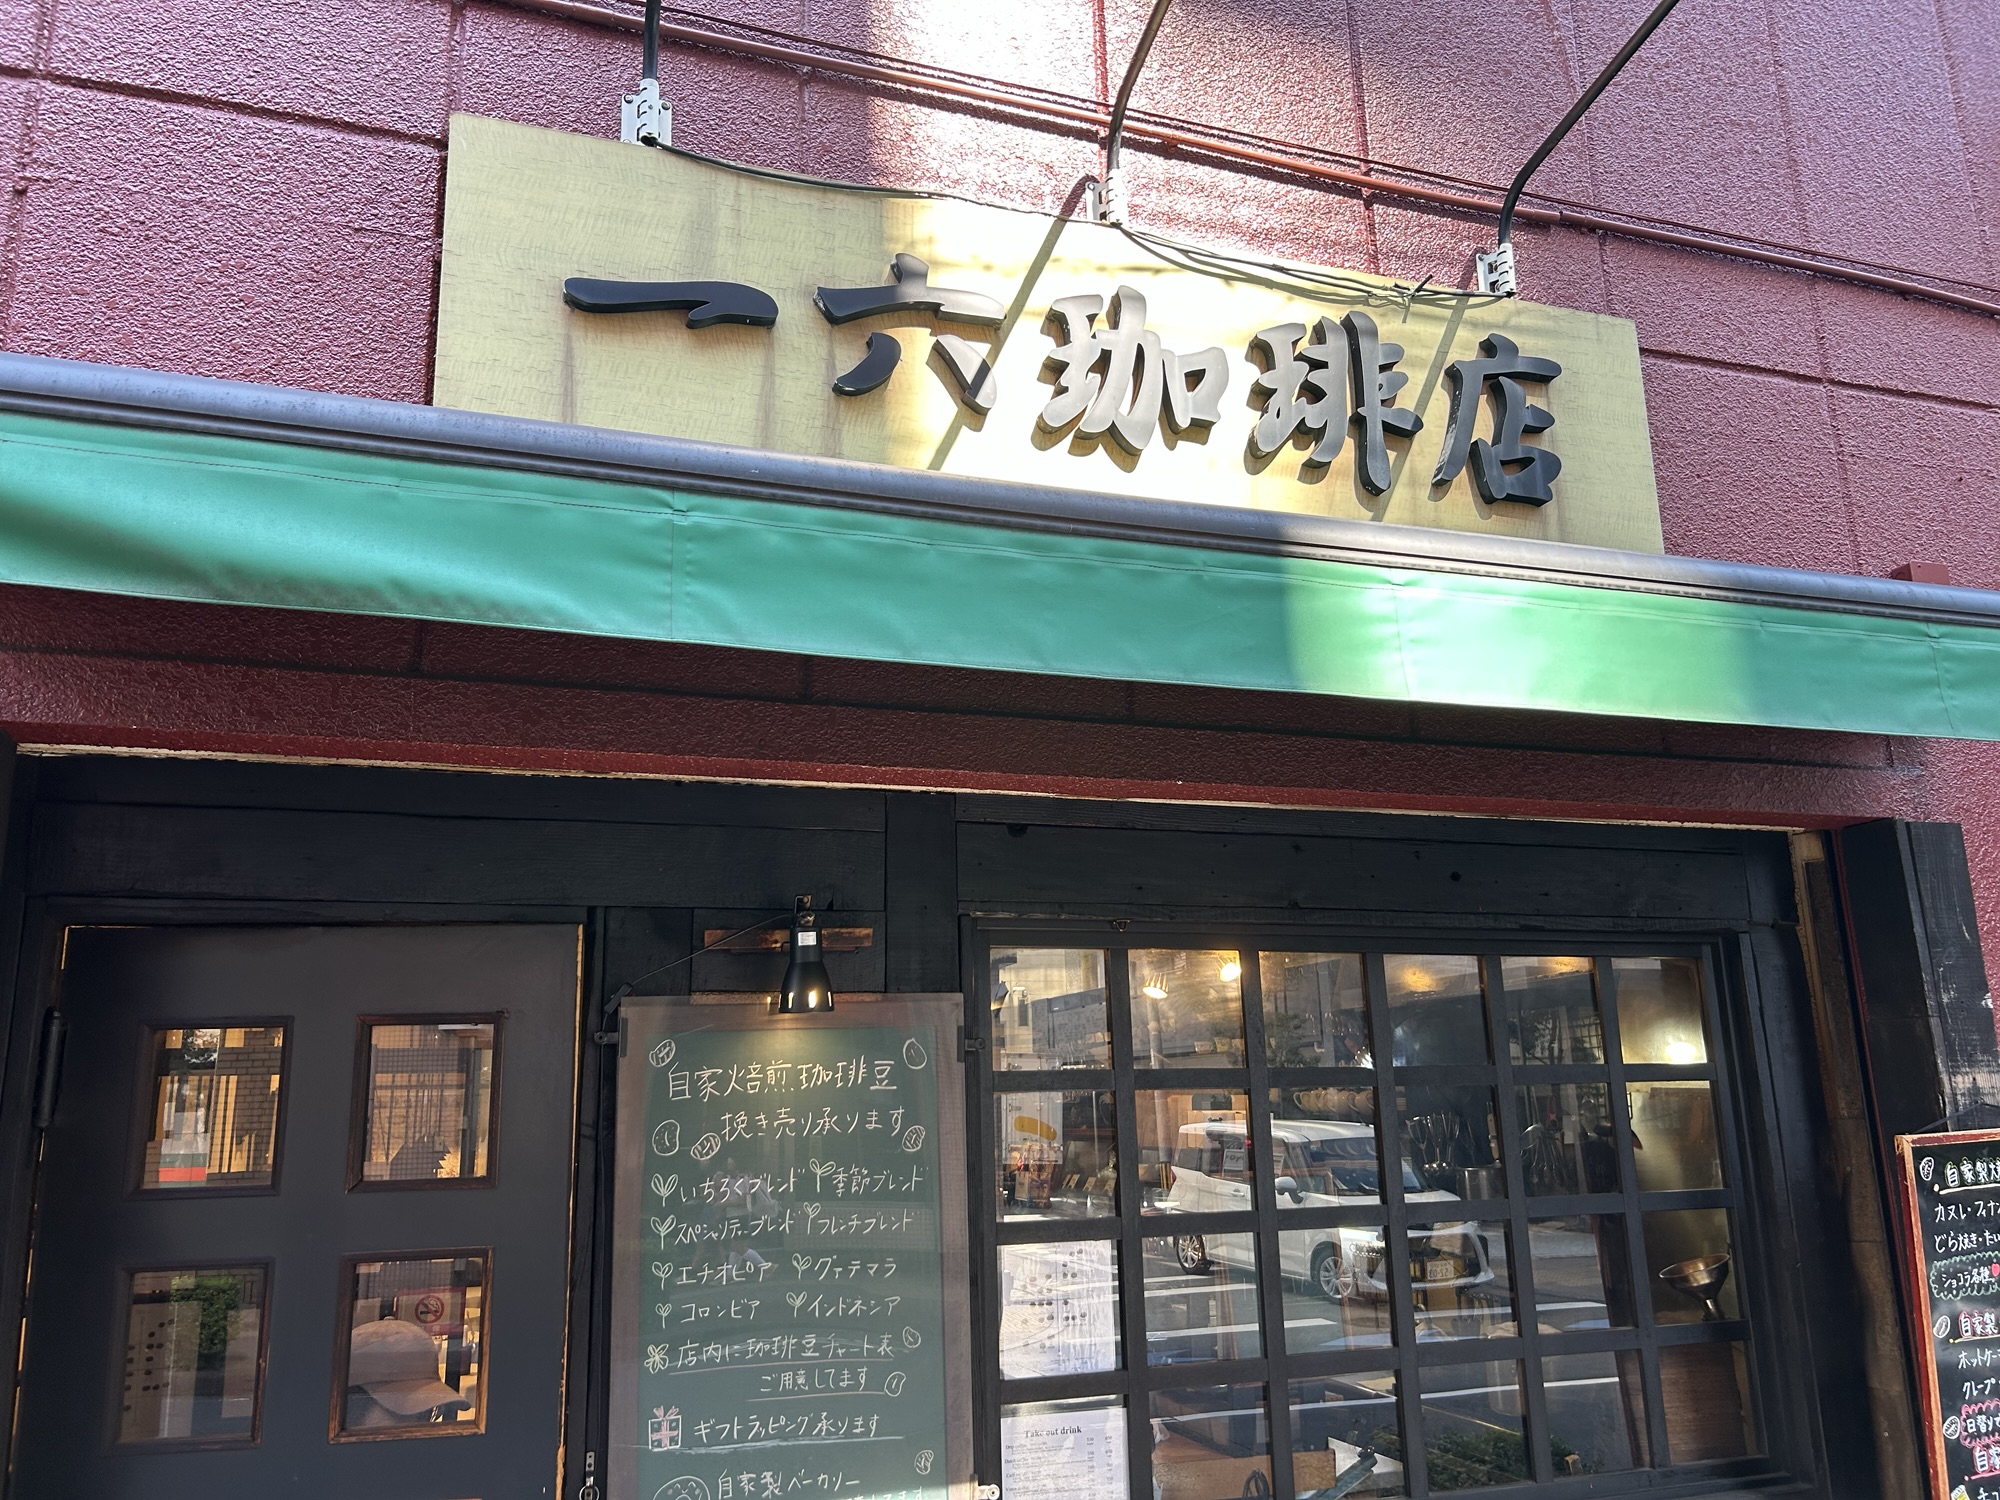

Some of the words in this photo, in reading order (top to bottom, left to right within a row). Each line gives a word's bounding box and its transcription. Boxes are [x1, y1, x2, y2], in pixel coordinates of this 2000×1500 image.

[563, 252, 1561, 506] 一六珈琲店
[668, 1055, 897, 1102] 自家焙煎珈琲豆
[720, 1106, 905, 1142] 挽き売り承ります
[680, 1166, 805, 1202] いちろくブレンド
[832, 1163, 929, 1197] 季節ブレンド
[817, 1208, 920, 1235] フレンチブレンド
[677, 1261, 773, 1285] エチオピア
[680, 1299, 760, 1323] コロンビア
[807, 1294, 900, 1318] インドネシア
[1960, 1311, 2000, 1337] 自家製
[677, 1332, 894, 1368] 店内に珈琲豆チャート表
[760, 1366, 867, 1391] ご用意してます
[693, 1411, 880, 1443] ギフトラッピング承ります
[1024, 1429, 1044, 1438] Take
[1045, 1428, 1059, 1437] out
[1060, 1425, 1082, 1435] drink
[717, 1468, 861, 1500] 自家製ベーカリー
